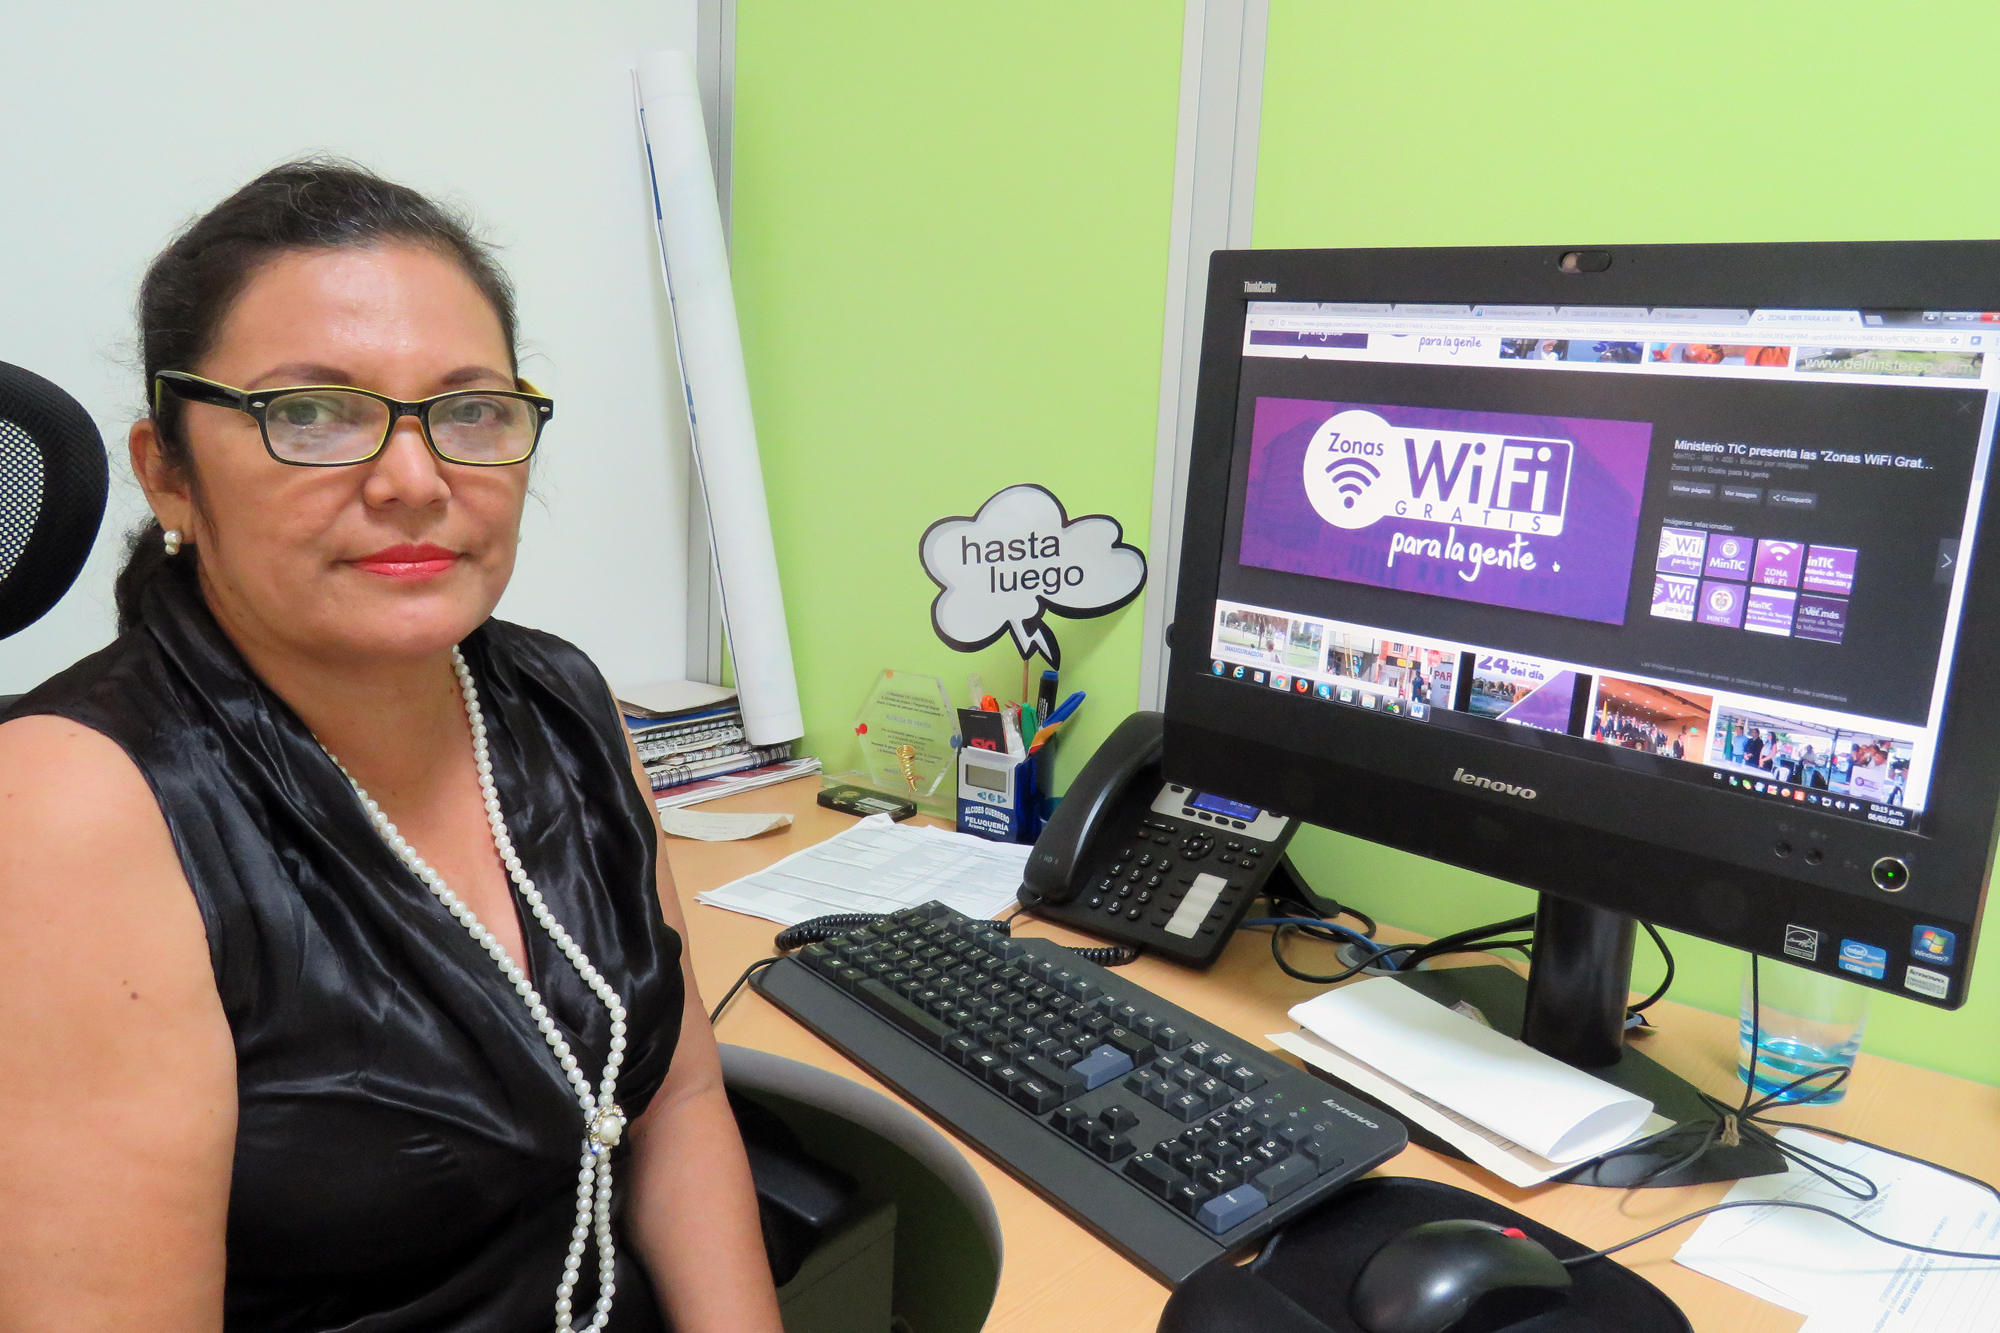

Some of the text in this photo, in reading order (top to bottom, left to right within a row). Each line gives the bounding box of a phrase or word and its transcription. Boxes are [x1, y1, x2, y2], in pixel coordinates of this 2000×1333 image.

[1244, 281, 1277, 293] ThinkCentre
[1418, 337, 1441, 352] para
[1450, 336, 1482, 355] gente
[1805, 357, 1973, 374] www.delfinstereo.com
[1327, 432, 1384, 456] Zonas
[1674, 440, 1724, 453] Ministerio
[1727, 443, 1747, 455] TIC
[1749, 446, 1797, 459] presenta
[1799, 449, 1817, 460] las
[1820, 450, 1861, 464] "Zonas
[1864, 453, 1892, 466] WiFi
[1404, 437, 1552, 512] WiFi
[1671, 464, 1690, 472] Zonas
[1692, 465, 1707, 473] WiFi
[1707, 467, 1726, 475] Gratis
[1728, 469, 1742, 477] para
[1724, 489, 1735, 497] Ver
[1781, 495, 1812, 504] Compartir
[1395, 500, 1542, 532] GRATIS
[961, 531, 1060, 565] hasta
[1387, 526, 1537, 582] para la gente
[1709, 557, 1746, 571] MinTIC
[990, 565, 1084, 595] luego
[1764, 567, 1788, 578] ZONA
[1763, 577, 1787, 586] WI-FI
[1810, 577, 1846, 588] Información
[1748, 600, 1772, 610] MinTIC
[1706, 615, 1731, 624] MINTIC
[1821, 611, 1840, 619] más
[1477, 655, 1510, 674] 24
[1510, 666, 1544, 681] del día
[1453, 767, 1537, 799] lenovo
[1713, 772, 1722, 780] ES
[965, 806, 1010, 824] ALCIDES GUERRERO
[965, 815, 1009, 832] PELUQUERÍA
[968, 823, 985, 831] Arauca
[1044, 855, 1053, 863] HD
[1322, 1099, 1379, 1129] lenovo
